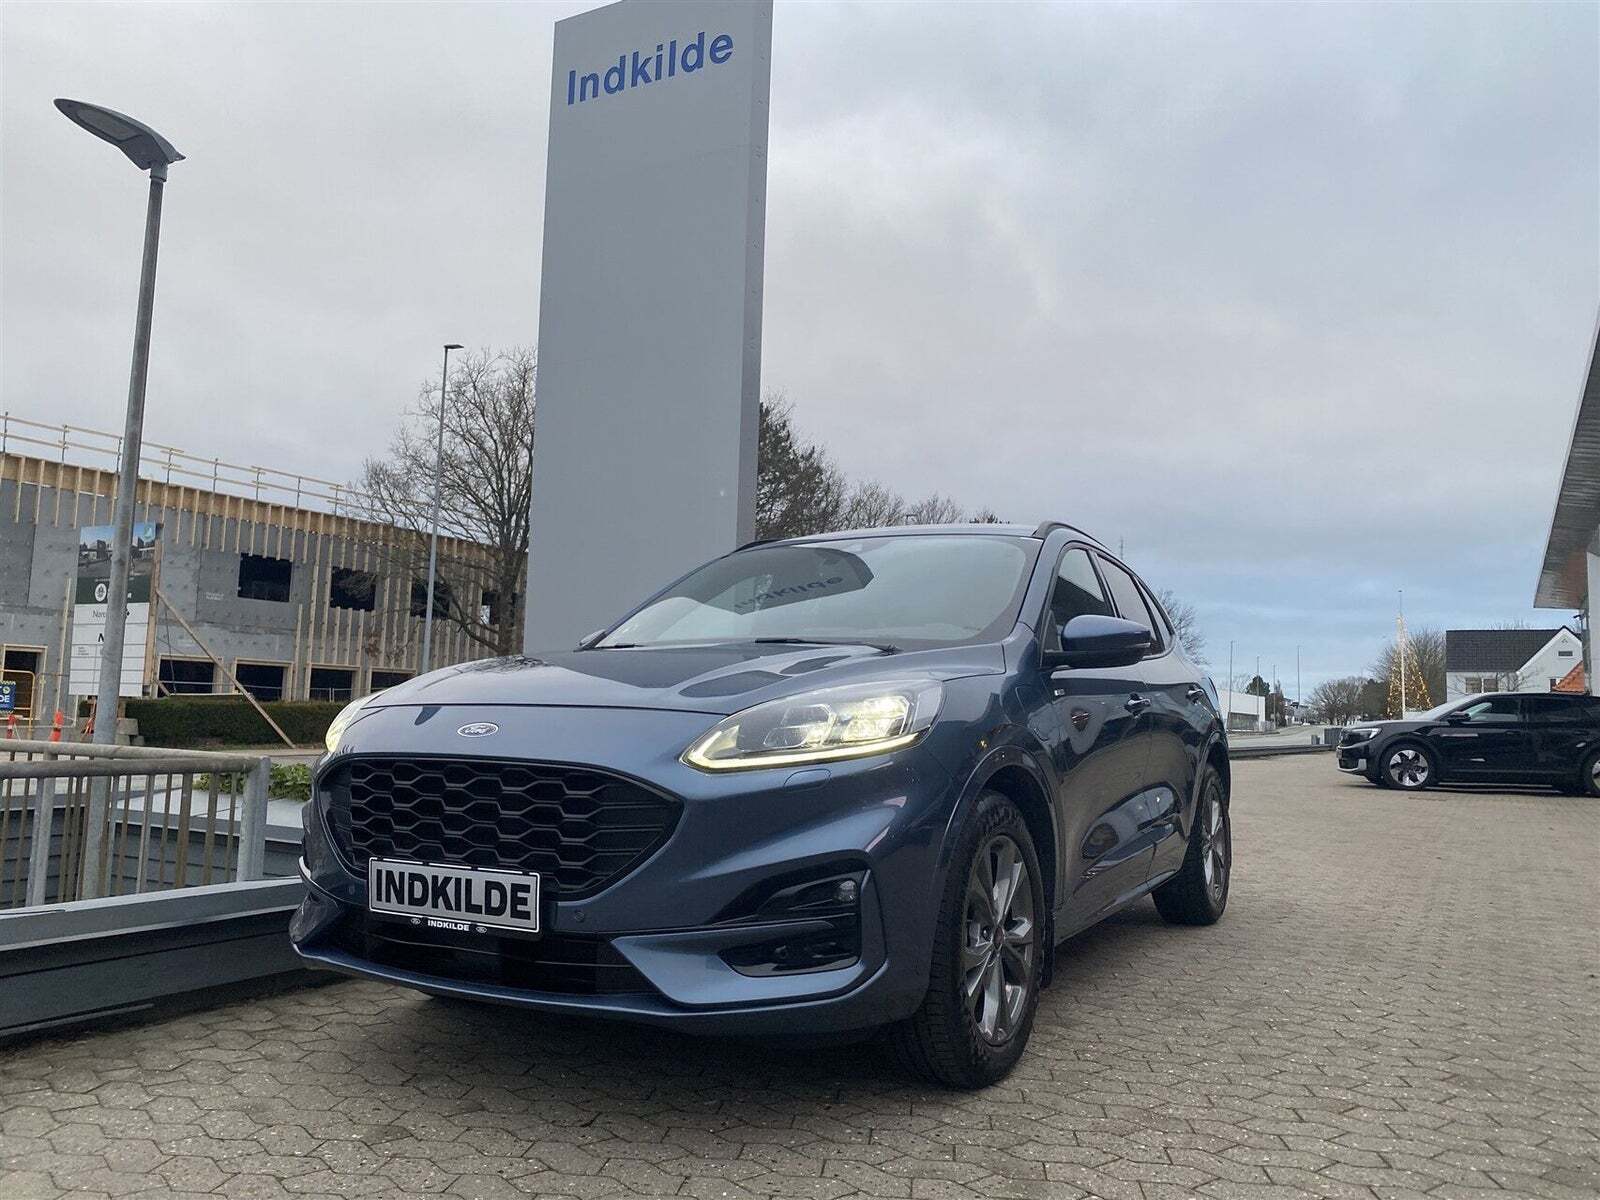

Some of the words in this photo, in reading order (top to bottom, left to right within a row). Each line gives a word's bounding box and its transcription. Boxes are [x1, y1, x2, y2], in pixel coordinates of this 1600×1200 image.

[568, 31, 734, 105] Indkilde
[376, 868, 531, 920] INDKILDE
[427, 919, 470, 932] INDKILDE
